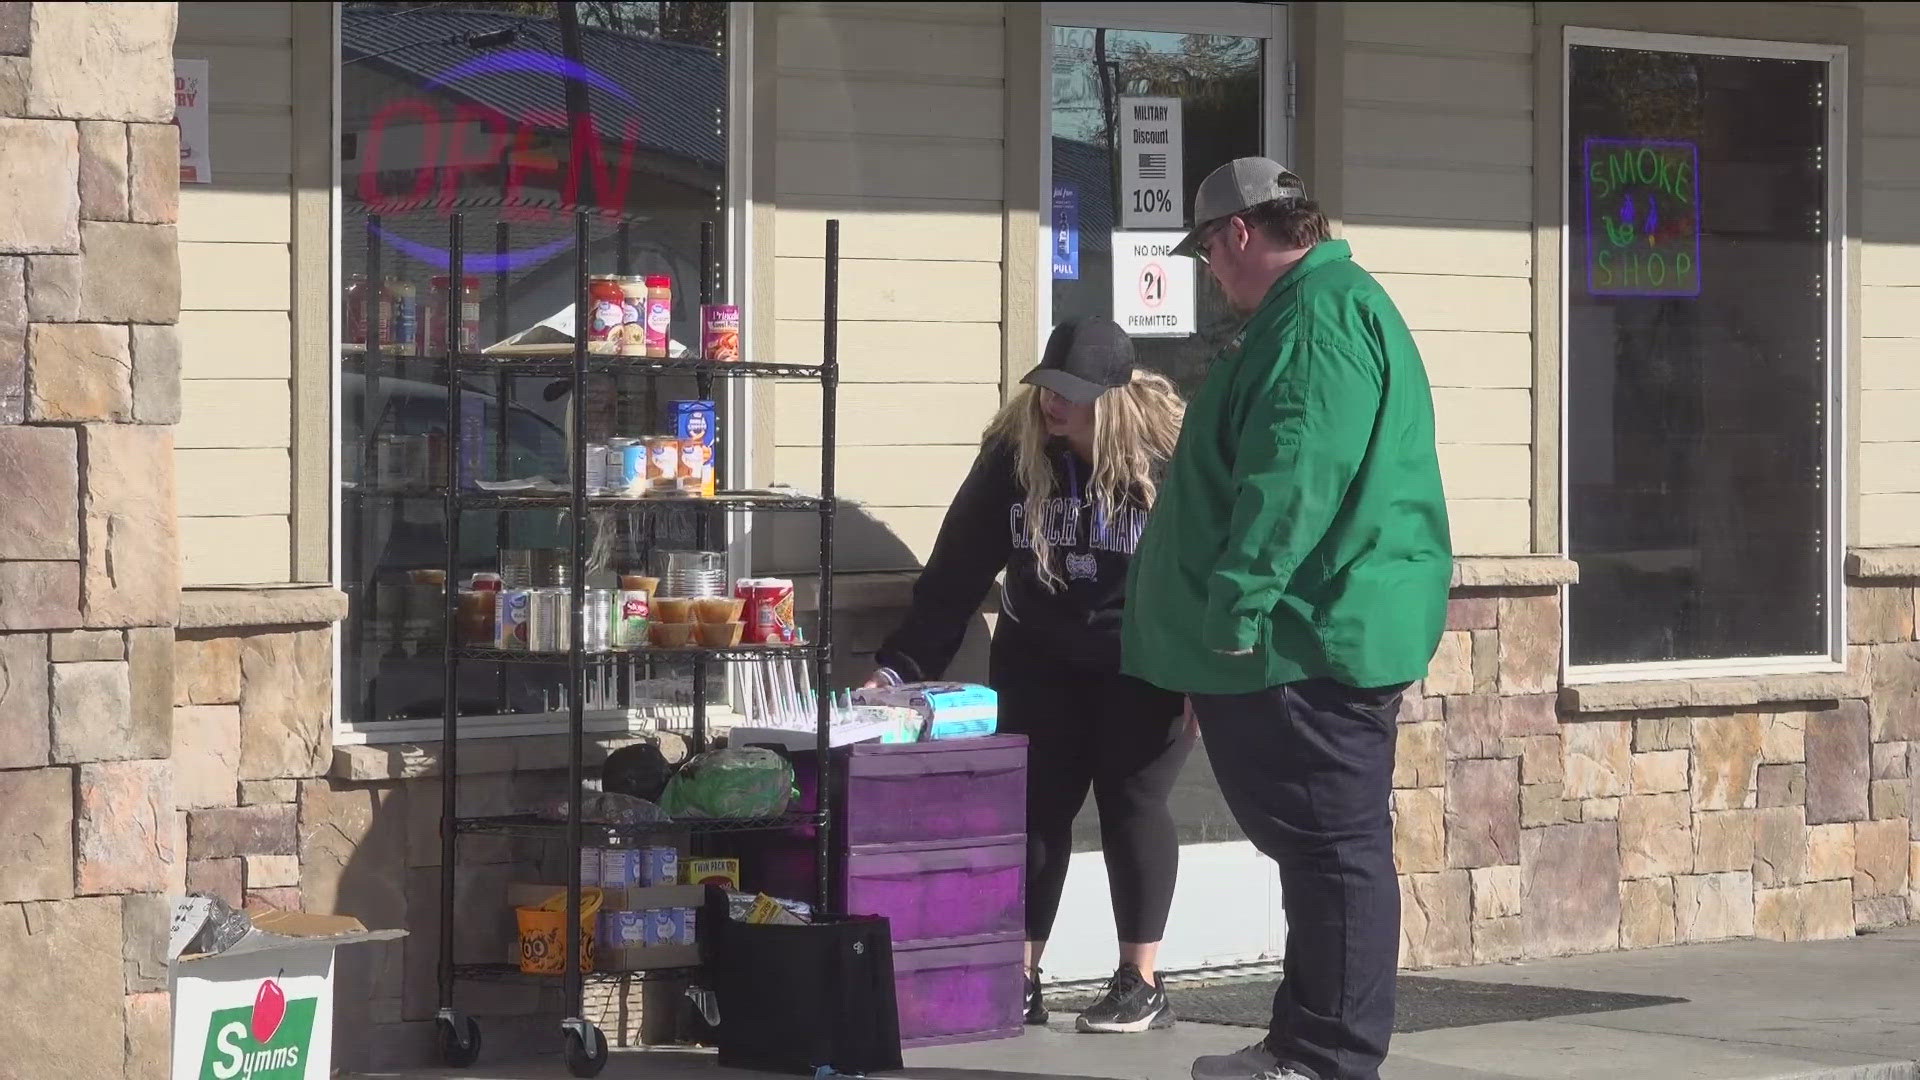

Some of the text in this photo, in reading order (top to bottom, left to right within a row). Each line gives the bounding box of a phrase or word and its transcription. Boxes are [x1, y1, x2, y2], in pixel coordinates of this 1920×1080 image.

[1133, 105, 1169, 121] MILITARY
[1133, 128, 1169, 144] Discount
[358, 96, 641, 223] OPEN
[1590, 147, 1691, 203] SMOKE
[1132, 189, 1172, 213] 10%
[1134, 245, 1171, 257] NO ONE
[1053, 263, 1074, 274] PULL
[1598, 250, 1691, 287] SHOP
[1143, 271, 1162, 300] 21
[1128, 314, 1178, 327] PERMITTED
[212, 1021, 300, 1080] Symms
